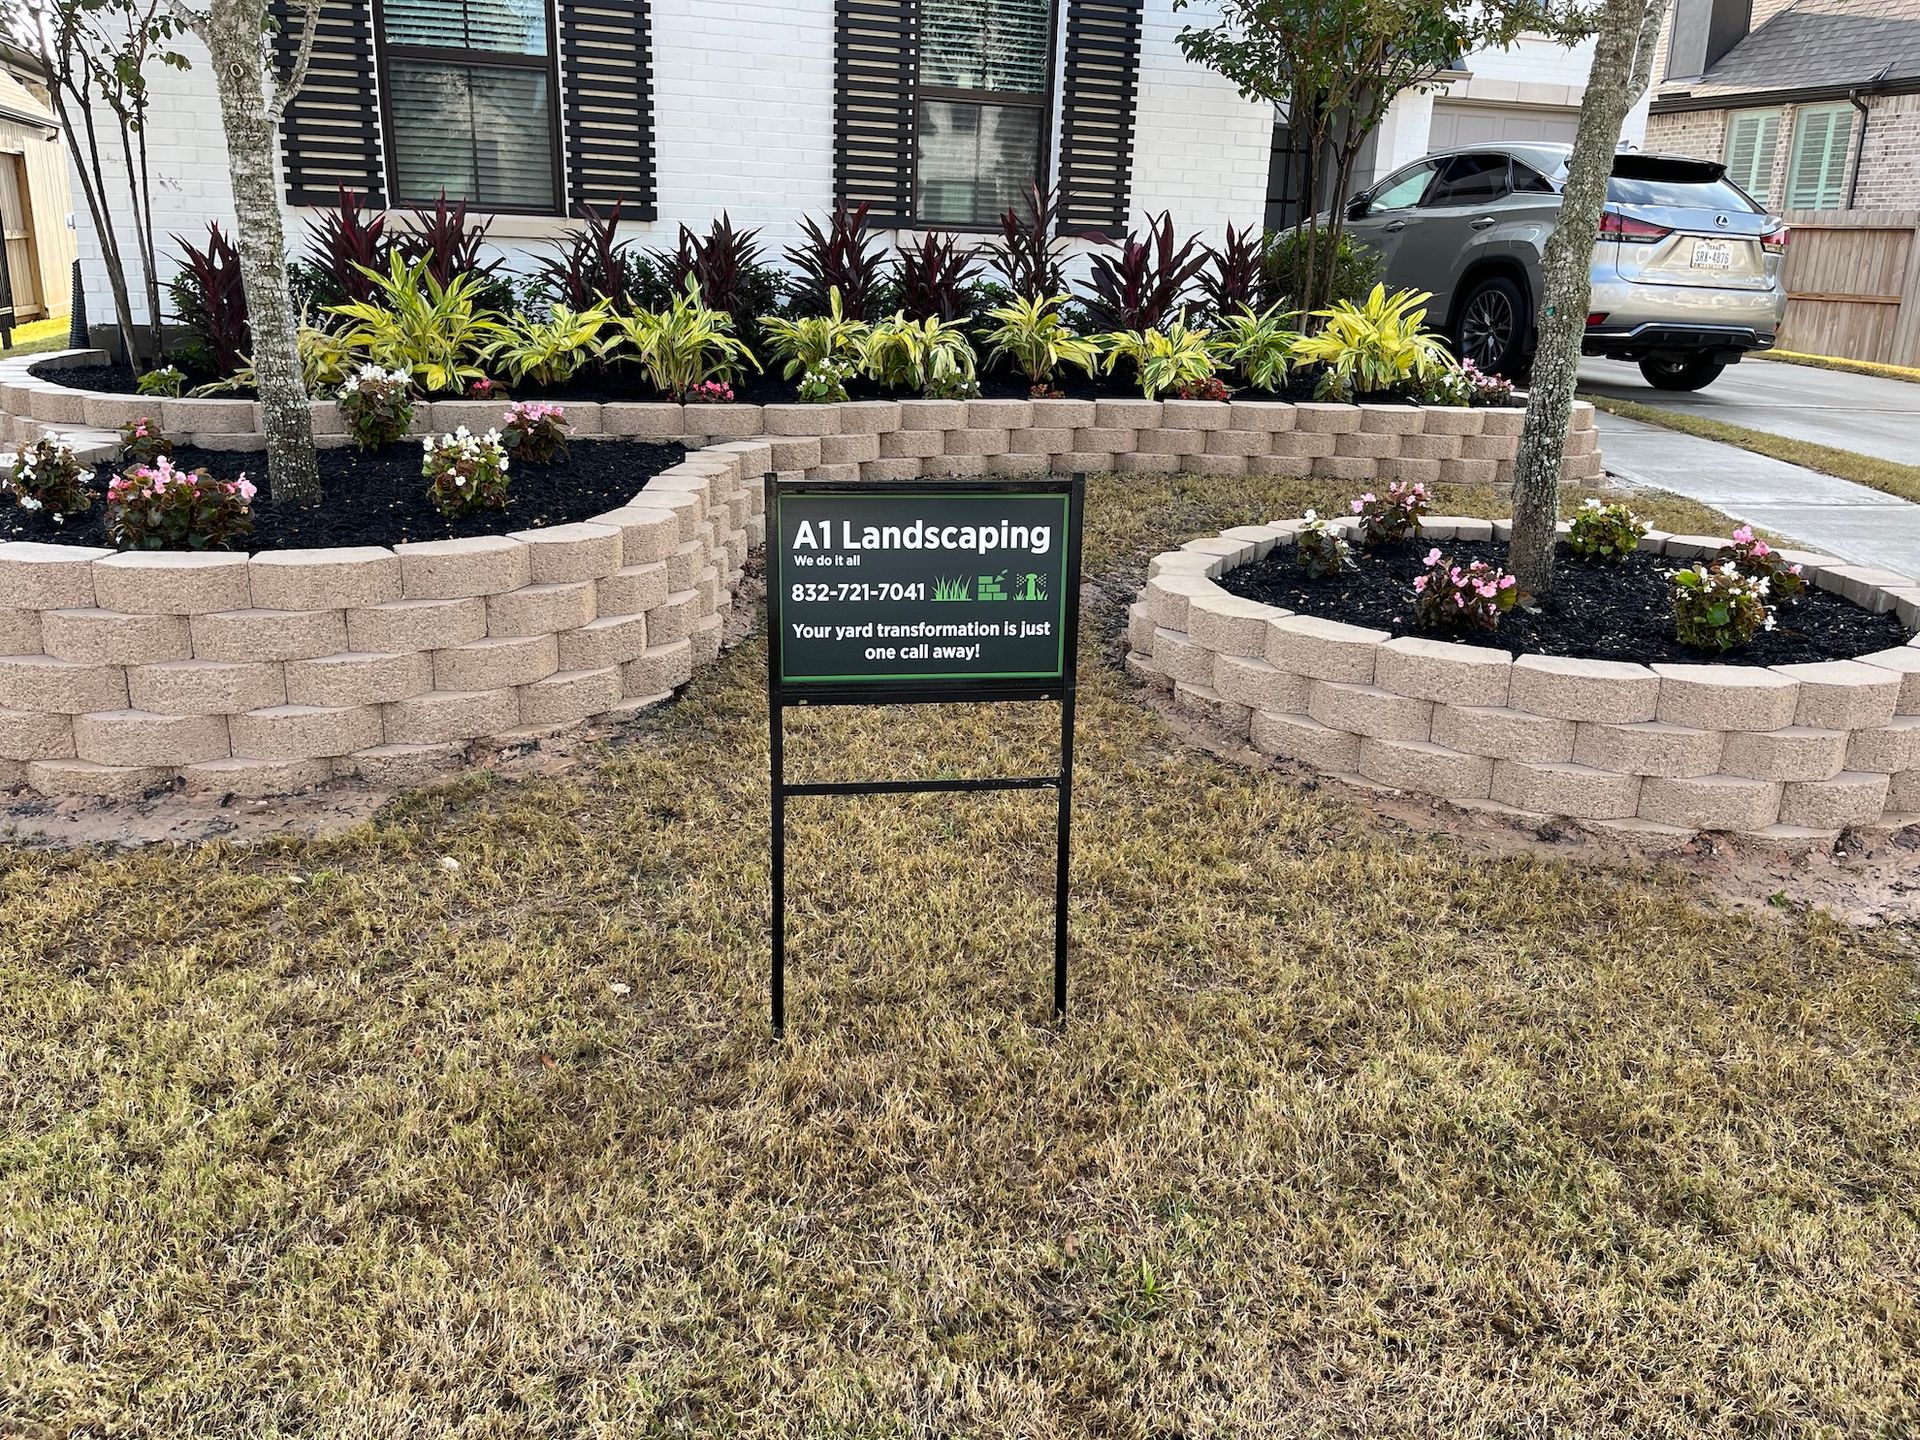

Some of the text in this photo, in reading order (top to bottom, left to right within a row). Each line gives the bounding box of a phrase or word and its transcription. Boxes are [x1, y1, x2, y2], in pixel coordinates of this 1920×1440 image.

[793, 520, 1050, 554] A1 Landscaping
[794, 555, 860, 566] We do it all
[792, 583, 924, 601] 832-721-7041
[793, 621, 1050, 640] Your yard transformation is just
[865, 644, 979, 660] one call away!
